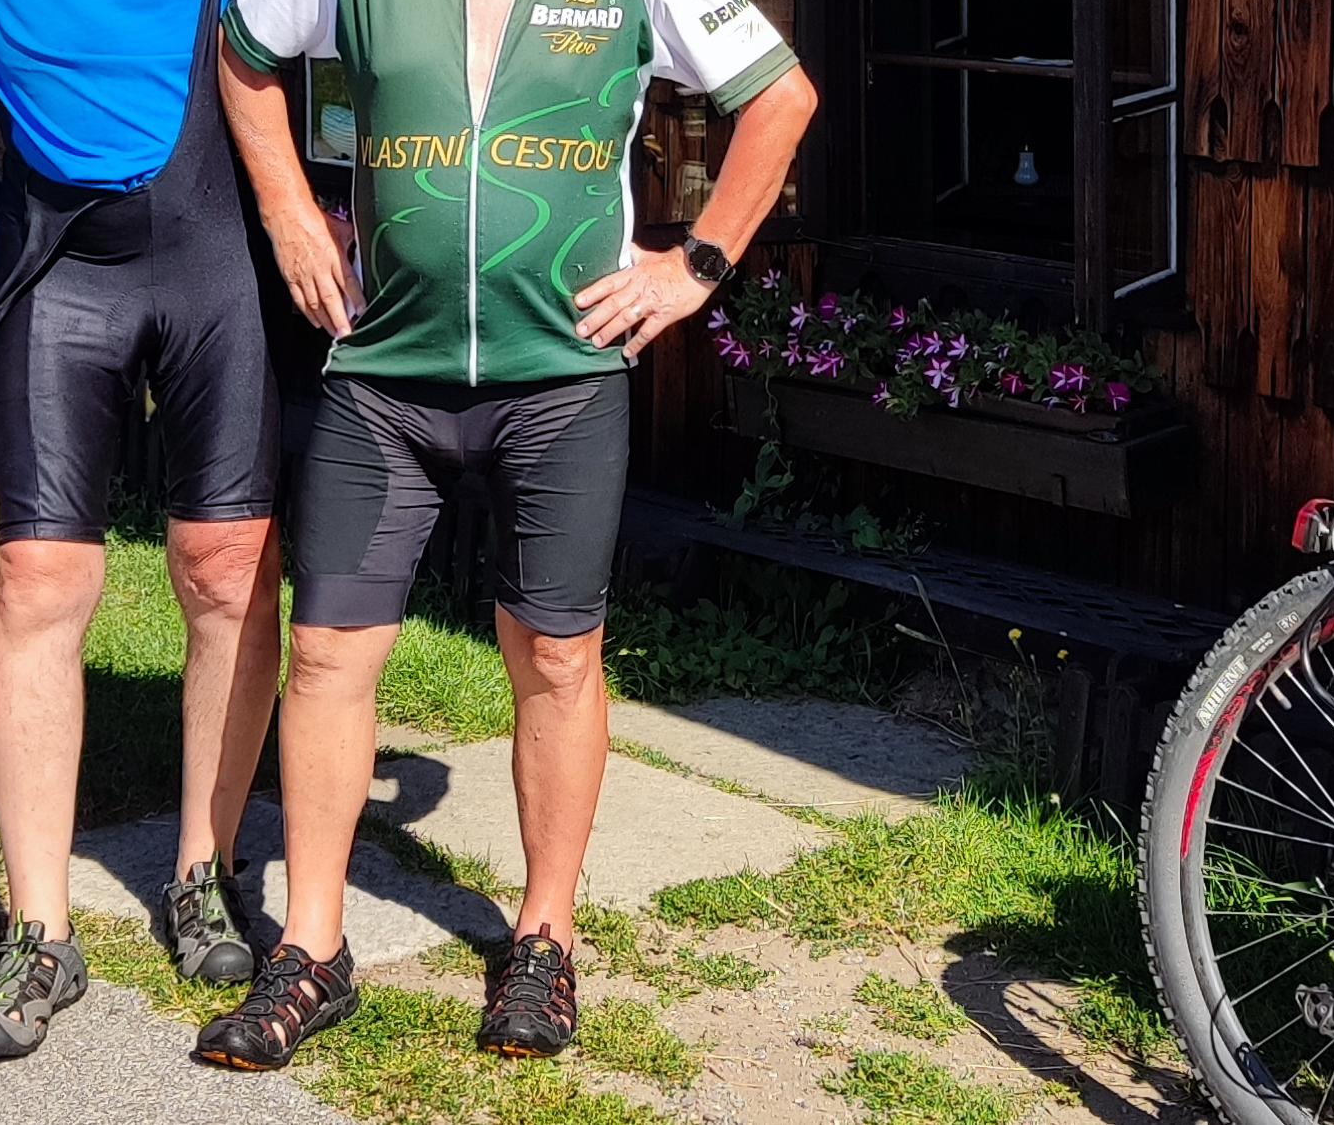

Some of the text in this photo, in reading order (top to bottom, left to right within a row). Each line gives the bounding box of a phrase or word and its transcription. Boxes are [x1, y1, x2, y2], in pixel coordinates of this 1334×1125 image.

[529, 3, 623, 30] BERNARD
[549, 29, 598, 55] Pivo
[360, 127, 614, 172] VLASTNÍ CESTOU
[1278, 612, 1300, 633] EXO
[1195, 654, 1249, 729] ARDENT
